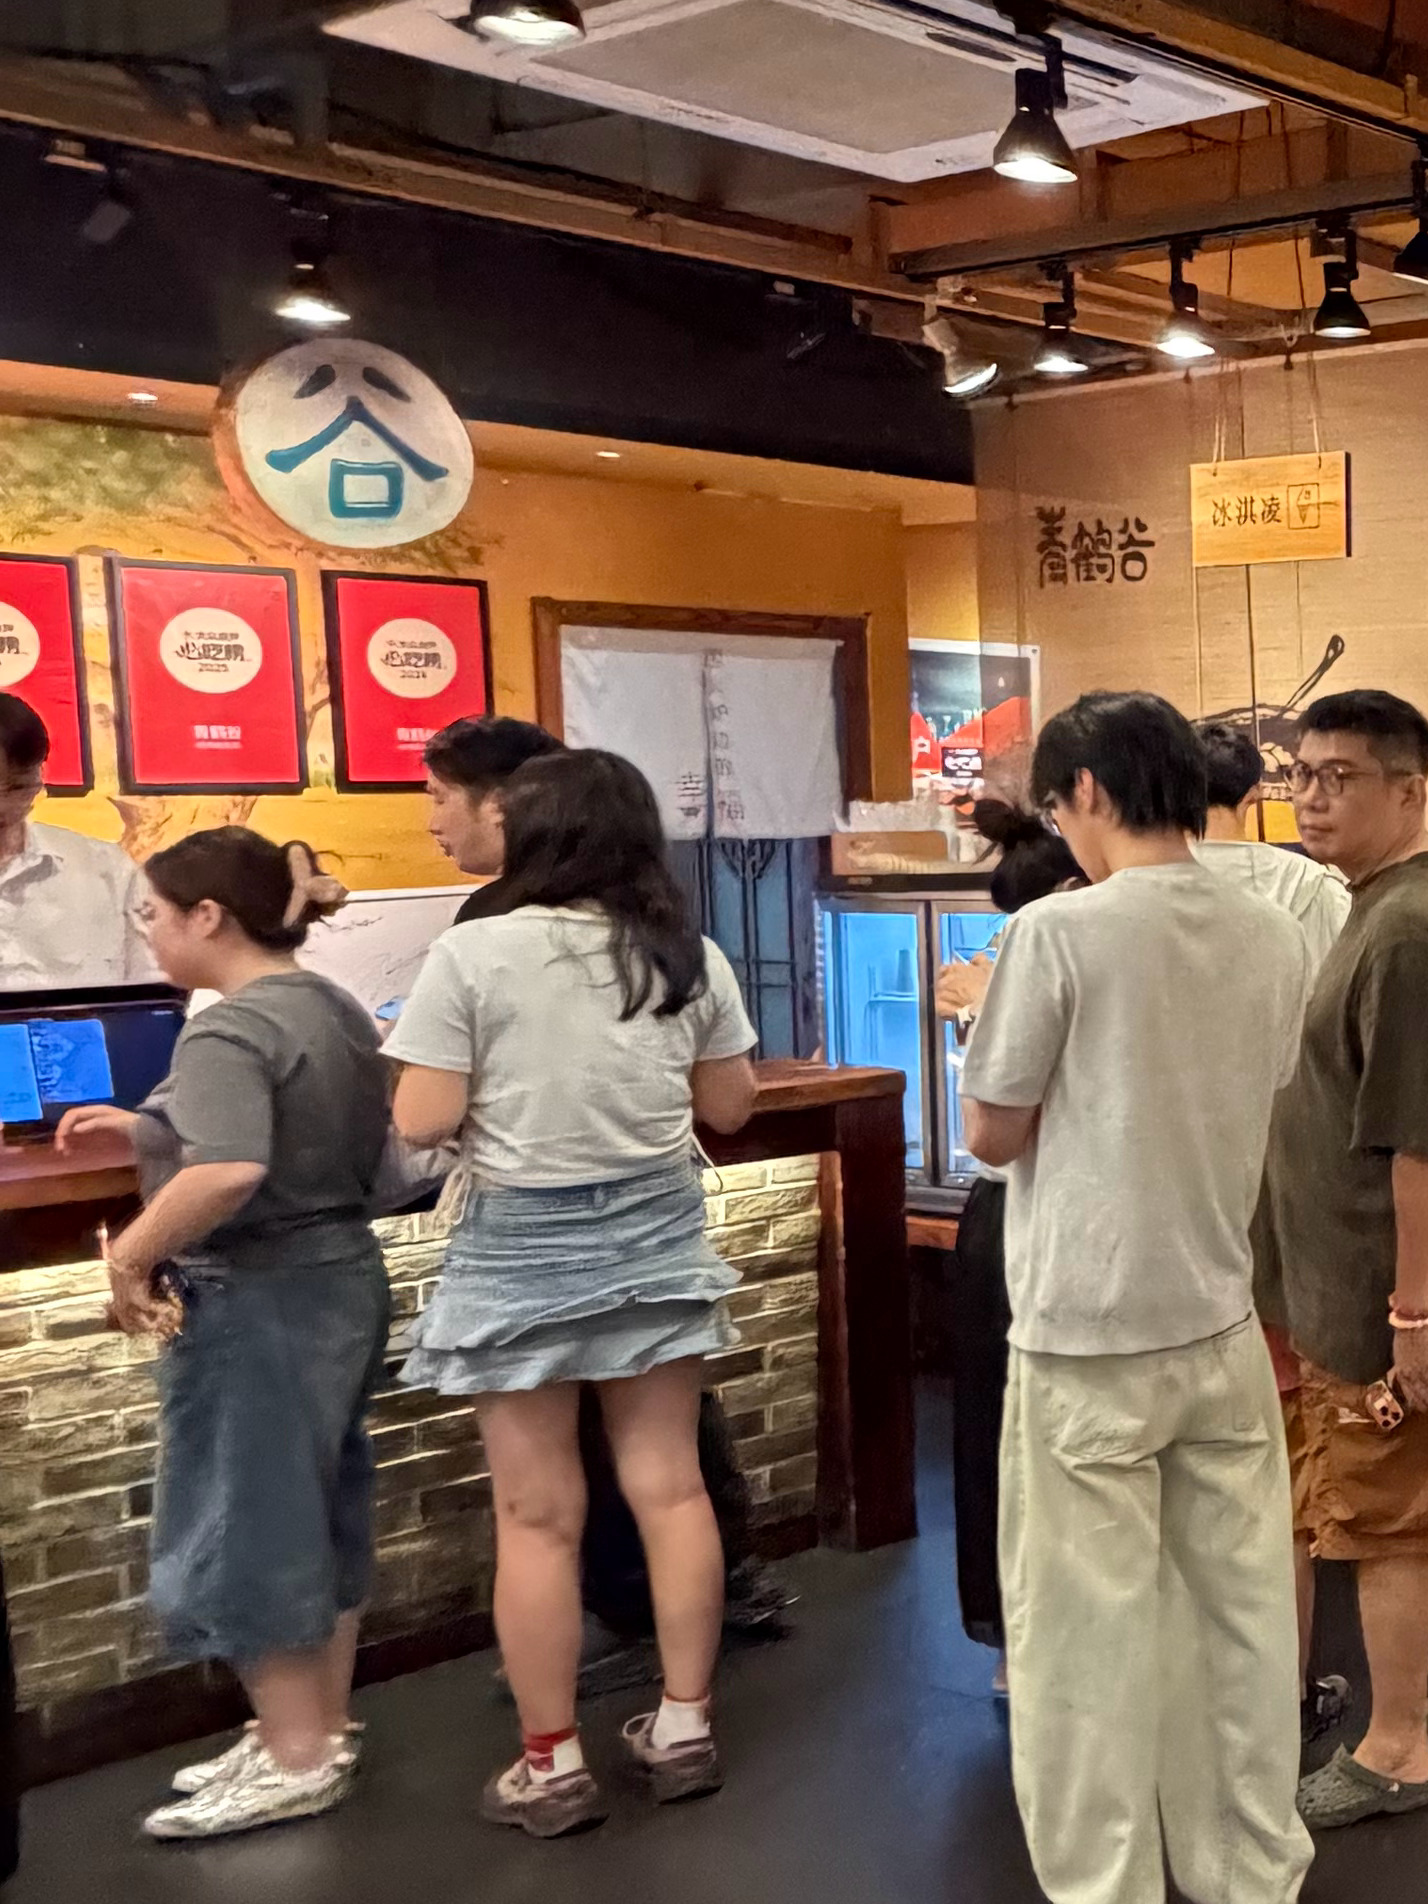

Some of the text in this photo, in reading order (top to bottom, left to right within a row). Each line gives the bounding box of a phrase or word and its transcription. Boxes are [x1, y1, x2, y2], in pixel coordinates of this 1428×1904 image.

[265, 363, 450, 520] 谷
[1212, 496, 1282, 527] 冰淇凌
